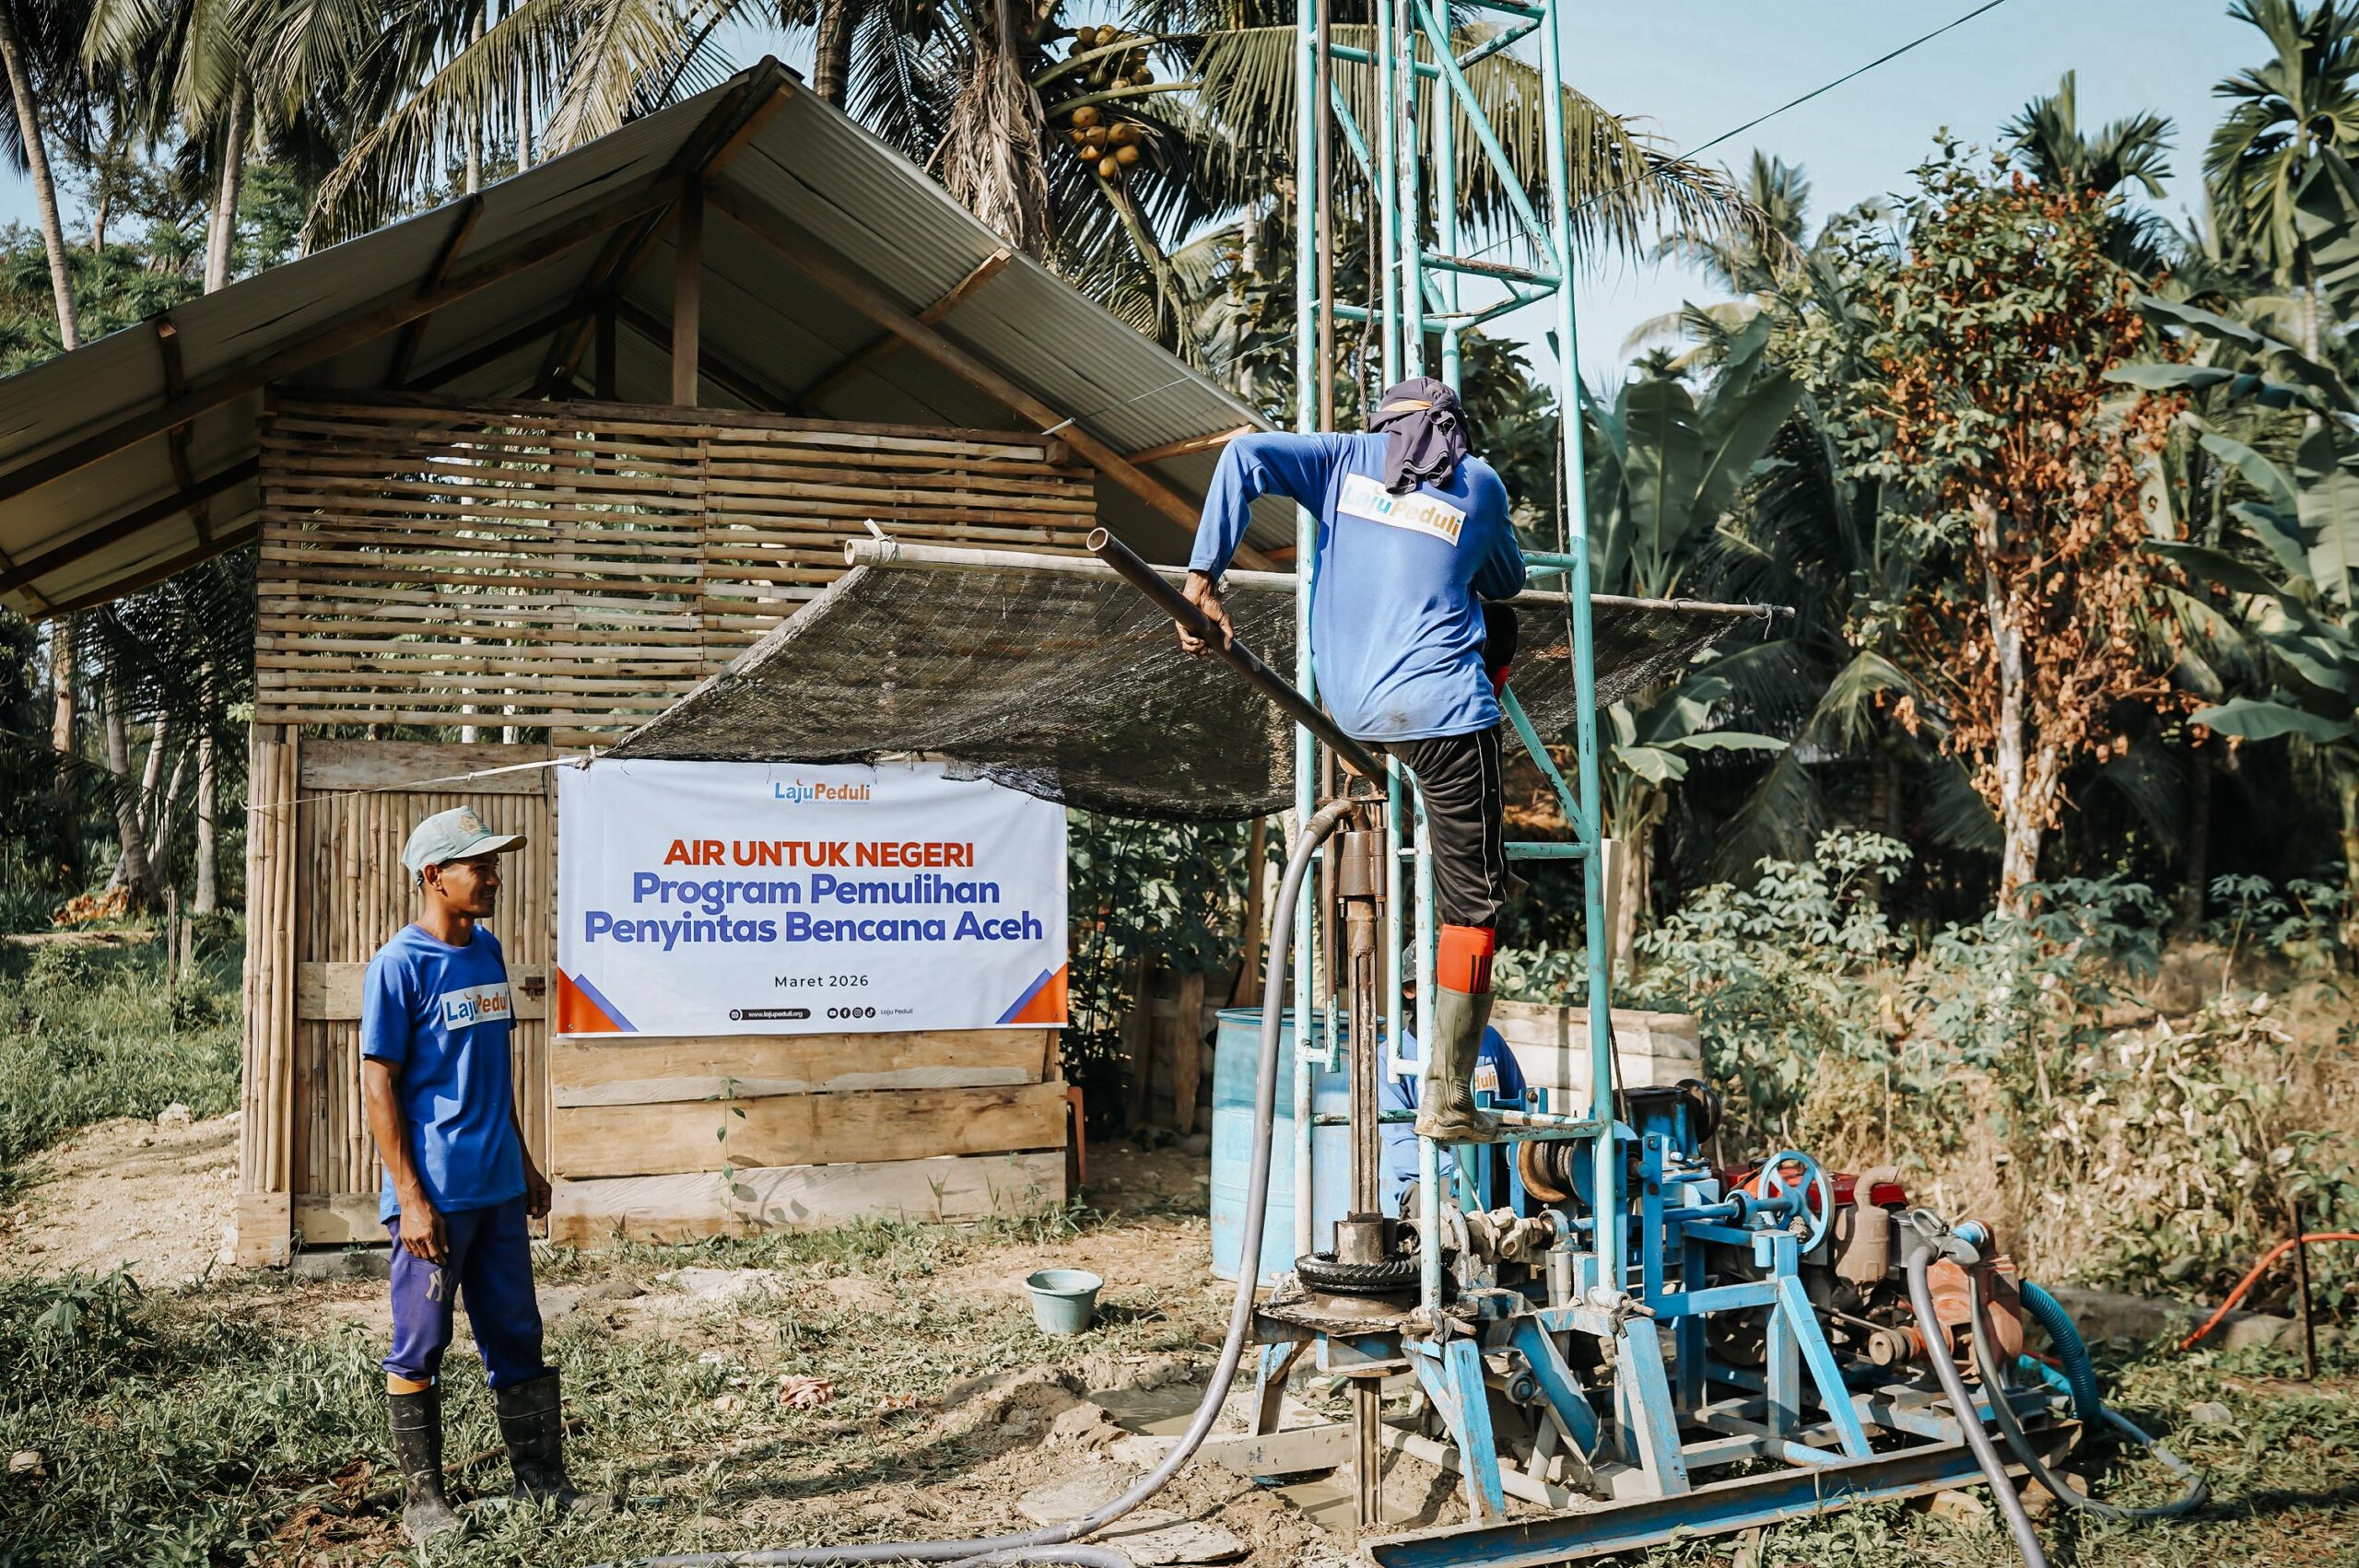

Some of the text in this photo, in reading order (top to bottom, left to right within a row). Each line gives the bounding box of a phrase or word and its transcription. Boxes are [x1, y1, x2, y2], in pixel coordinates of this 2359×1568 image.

[774, 778, 871, 803] LajuPeduli
[663, 839, 974, 868] AIR UNTUK NEGERI
[633, 872, 1000, 915] Program Pemulihan
[585, 910, 1043, 952] Penyintas Bencana Aceh
[775, 975, 869, 988] Maret 2026
[880, 1009, 894, 1017] Laju
